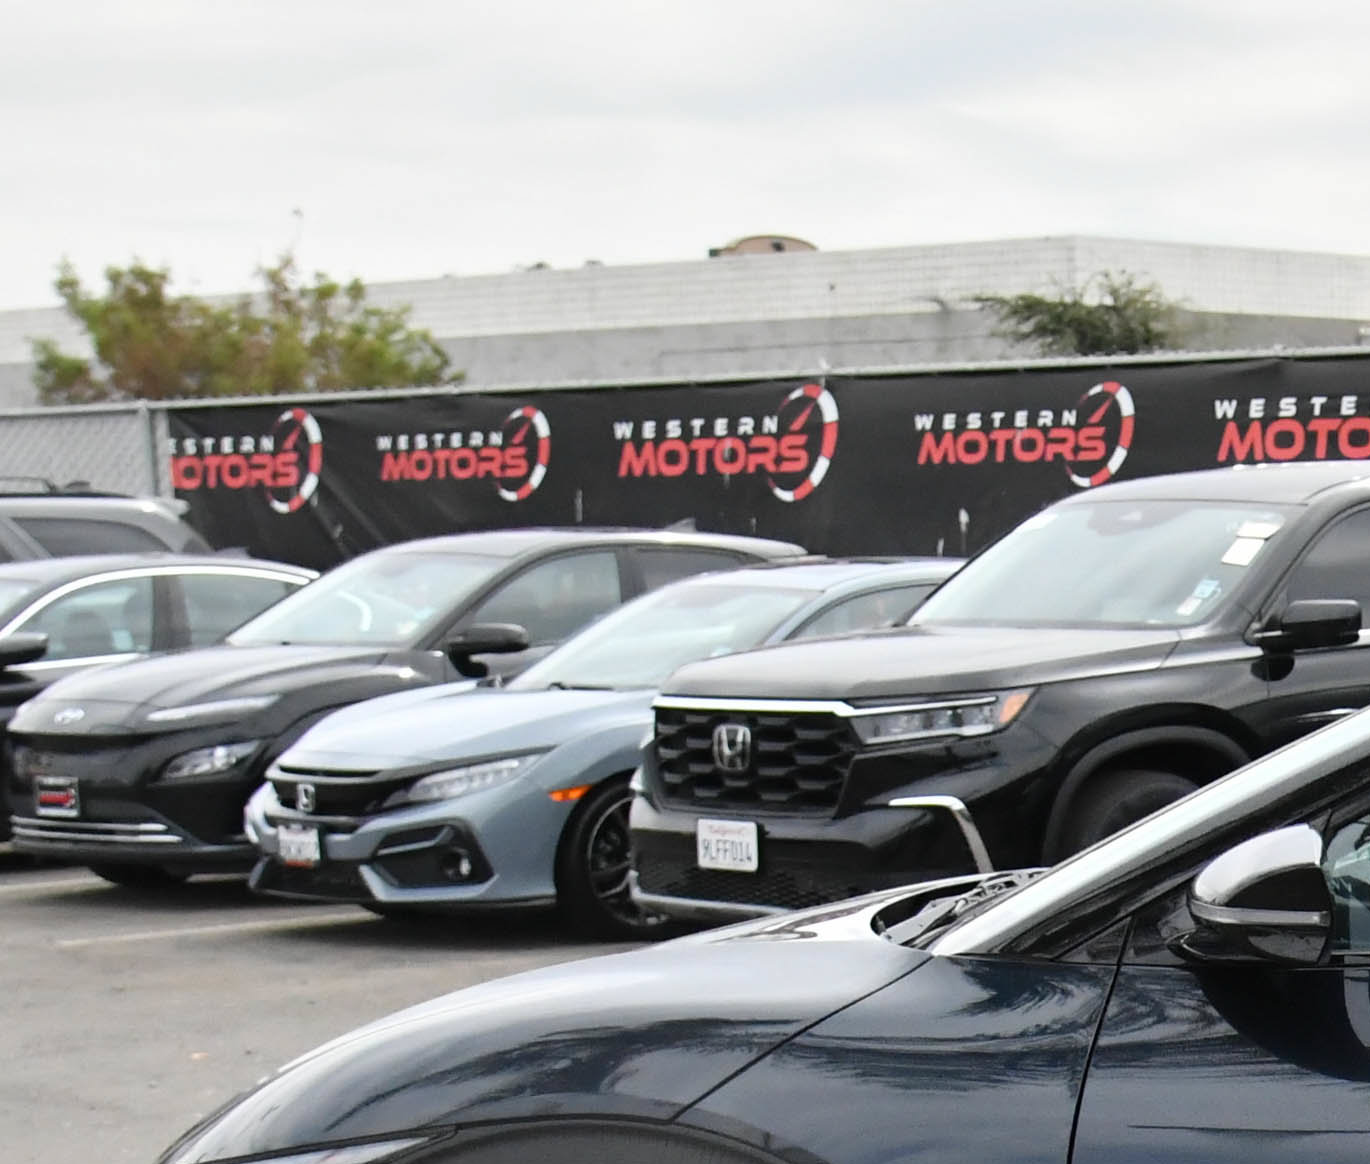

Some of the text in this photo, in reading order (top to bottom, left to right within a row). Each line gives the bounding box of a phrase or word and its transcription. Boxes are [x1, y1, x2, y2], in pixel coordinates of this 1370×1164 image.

[613, 415, 779, 440] WESTERN
[914, 409, 1077, 431] WESTERN
[166, 436, 274, 455] ESTERN
[376, 431, 503, 451] WESTERN
[918, 427, 1108, 465] MOTORS
[170, 450, 300, 490] OTORS
[380, 447, 529, 481] MOTORS
[618, 436, 809, 478] MOTORS
